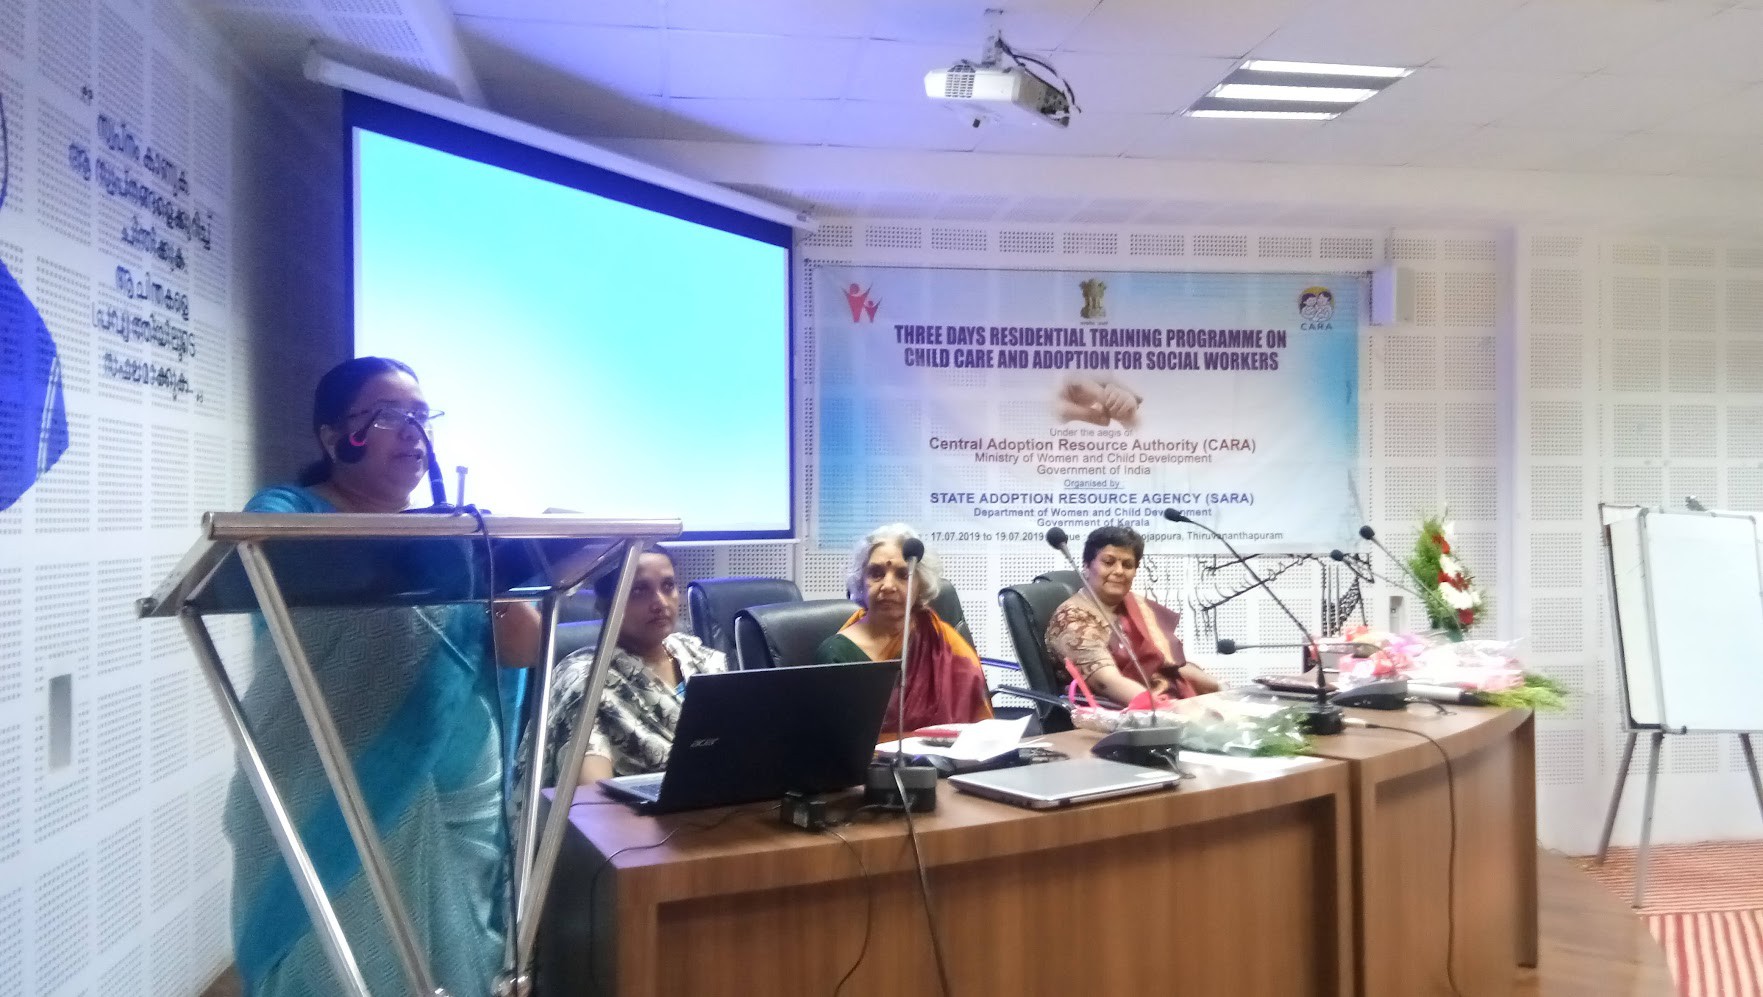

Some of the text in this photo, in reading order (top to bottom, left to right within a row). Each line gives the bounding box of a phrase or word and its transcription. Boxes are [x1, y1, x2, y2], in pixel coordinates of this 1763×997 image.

[1300, 322, 1333, 331] CARA
[894, 324, 1287, 349] THREE DAYS RESIDENTIAL TRAINING PROGRAMME ON
[904, 347, 1279, 371] CHILD CARE AND ADOPTION FOR SOCIAL WORKERS
[1050, 428, 1134, 439] Under the aegis of
[929, 437, 1256, 454] Central Adoption Resource Authority (CARA)
[975, 453, 1212, 465] Ministry of Women and Child Development
[1036, 464, 1151, 475] Government of India
[1063, 479, 1120, 489] Organised by
[930, 492, 1254, 506] STATE ADOPTION RESOURCE AGENCY (SARA)
[973, 507, 1034, 518] Department
[1037, 507, 1048, 517] of
[1050, 508, 1088, 517] Women
[1092, 508, 1111, 517] and
[1114, 507, 1141, 517] Child
[1037, 518, 1150, 527] Government of Kerala
[931, 531, 980, 541] 17.07.2019
[982, 532, 993, 541] to
[995, 531, 1044, 541] 19.07.2019
